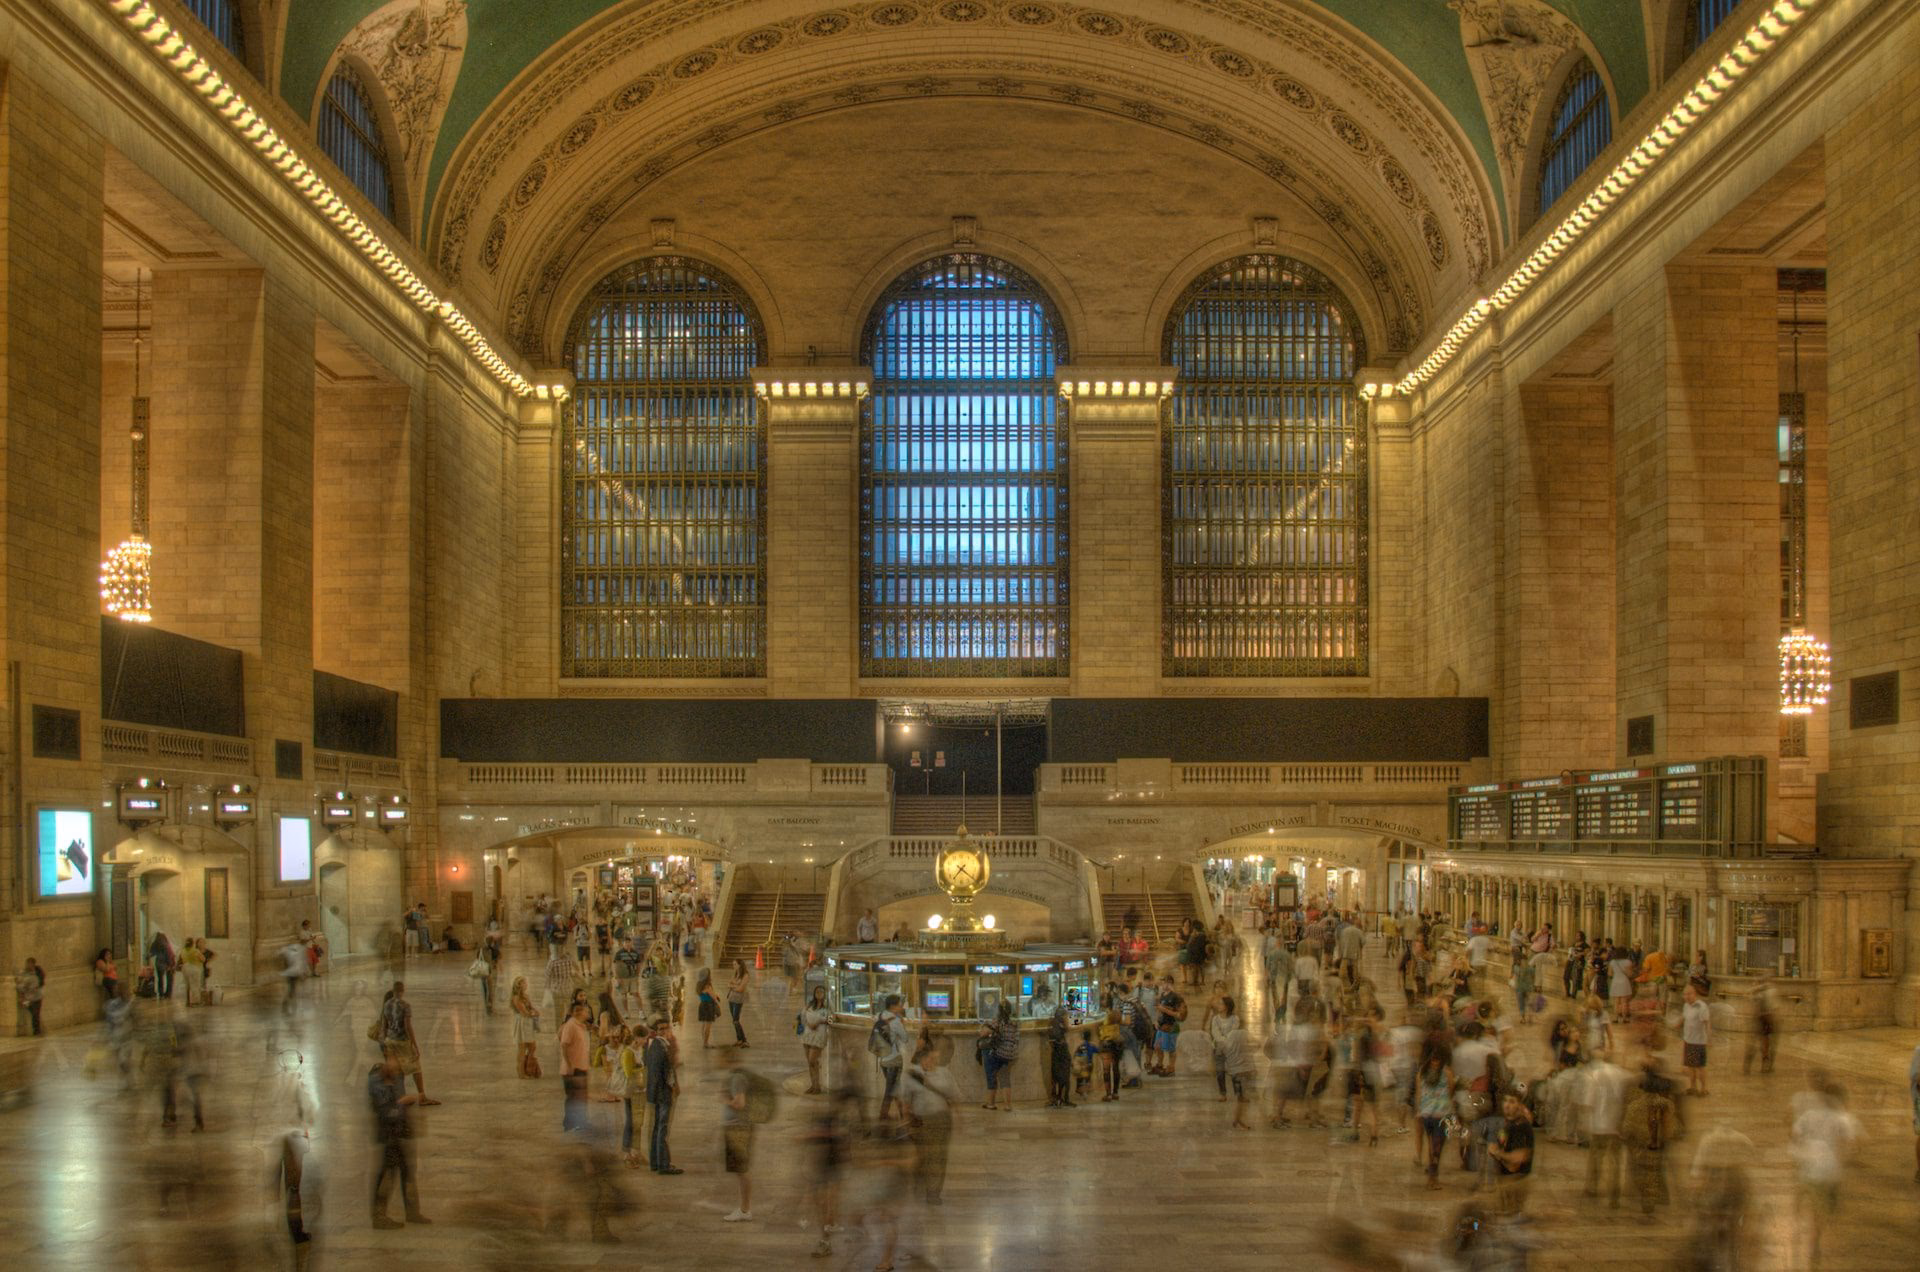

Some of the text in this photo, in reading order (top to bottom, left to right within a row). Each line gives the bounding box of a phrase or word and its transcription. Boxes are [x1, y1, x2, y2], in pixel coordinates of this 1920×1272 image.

[623, 816, 678, 832] LEXINGTON
[1229, 816, 1305, 836] LEXINGTON AVE
[1339, 815, 1421, 836] TICKET MACHINES
[632, 846, 664, 854] PASSAGE
[1239, 846, 1271, 854] PASSAGE
[1277, 847, 1309, 855] SUBWAY
